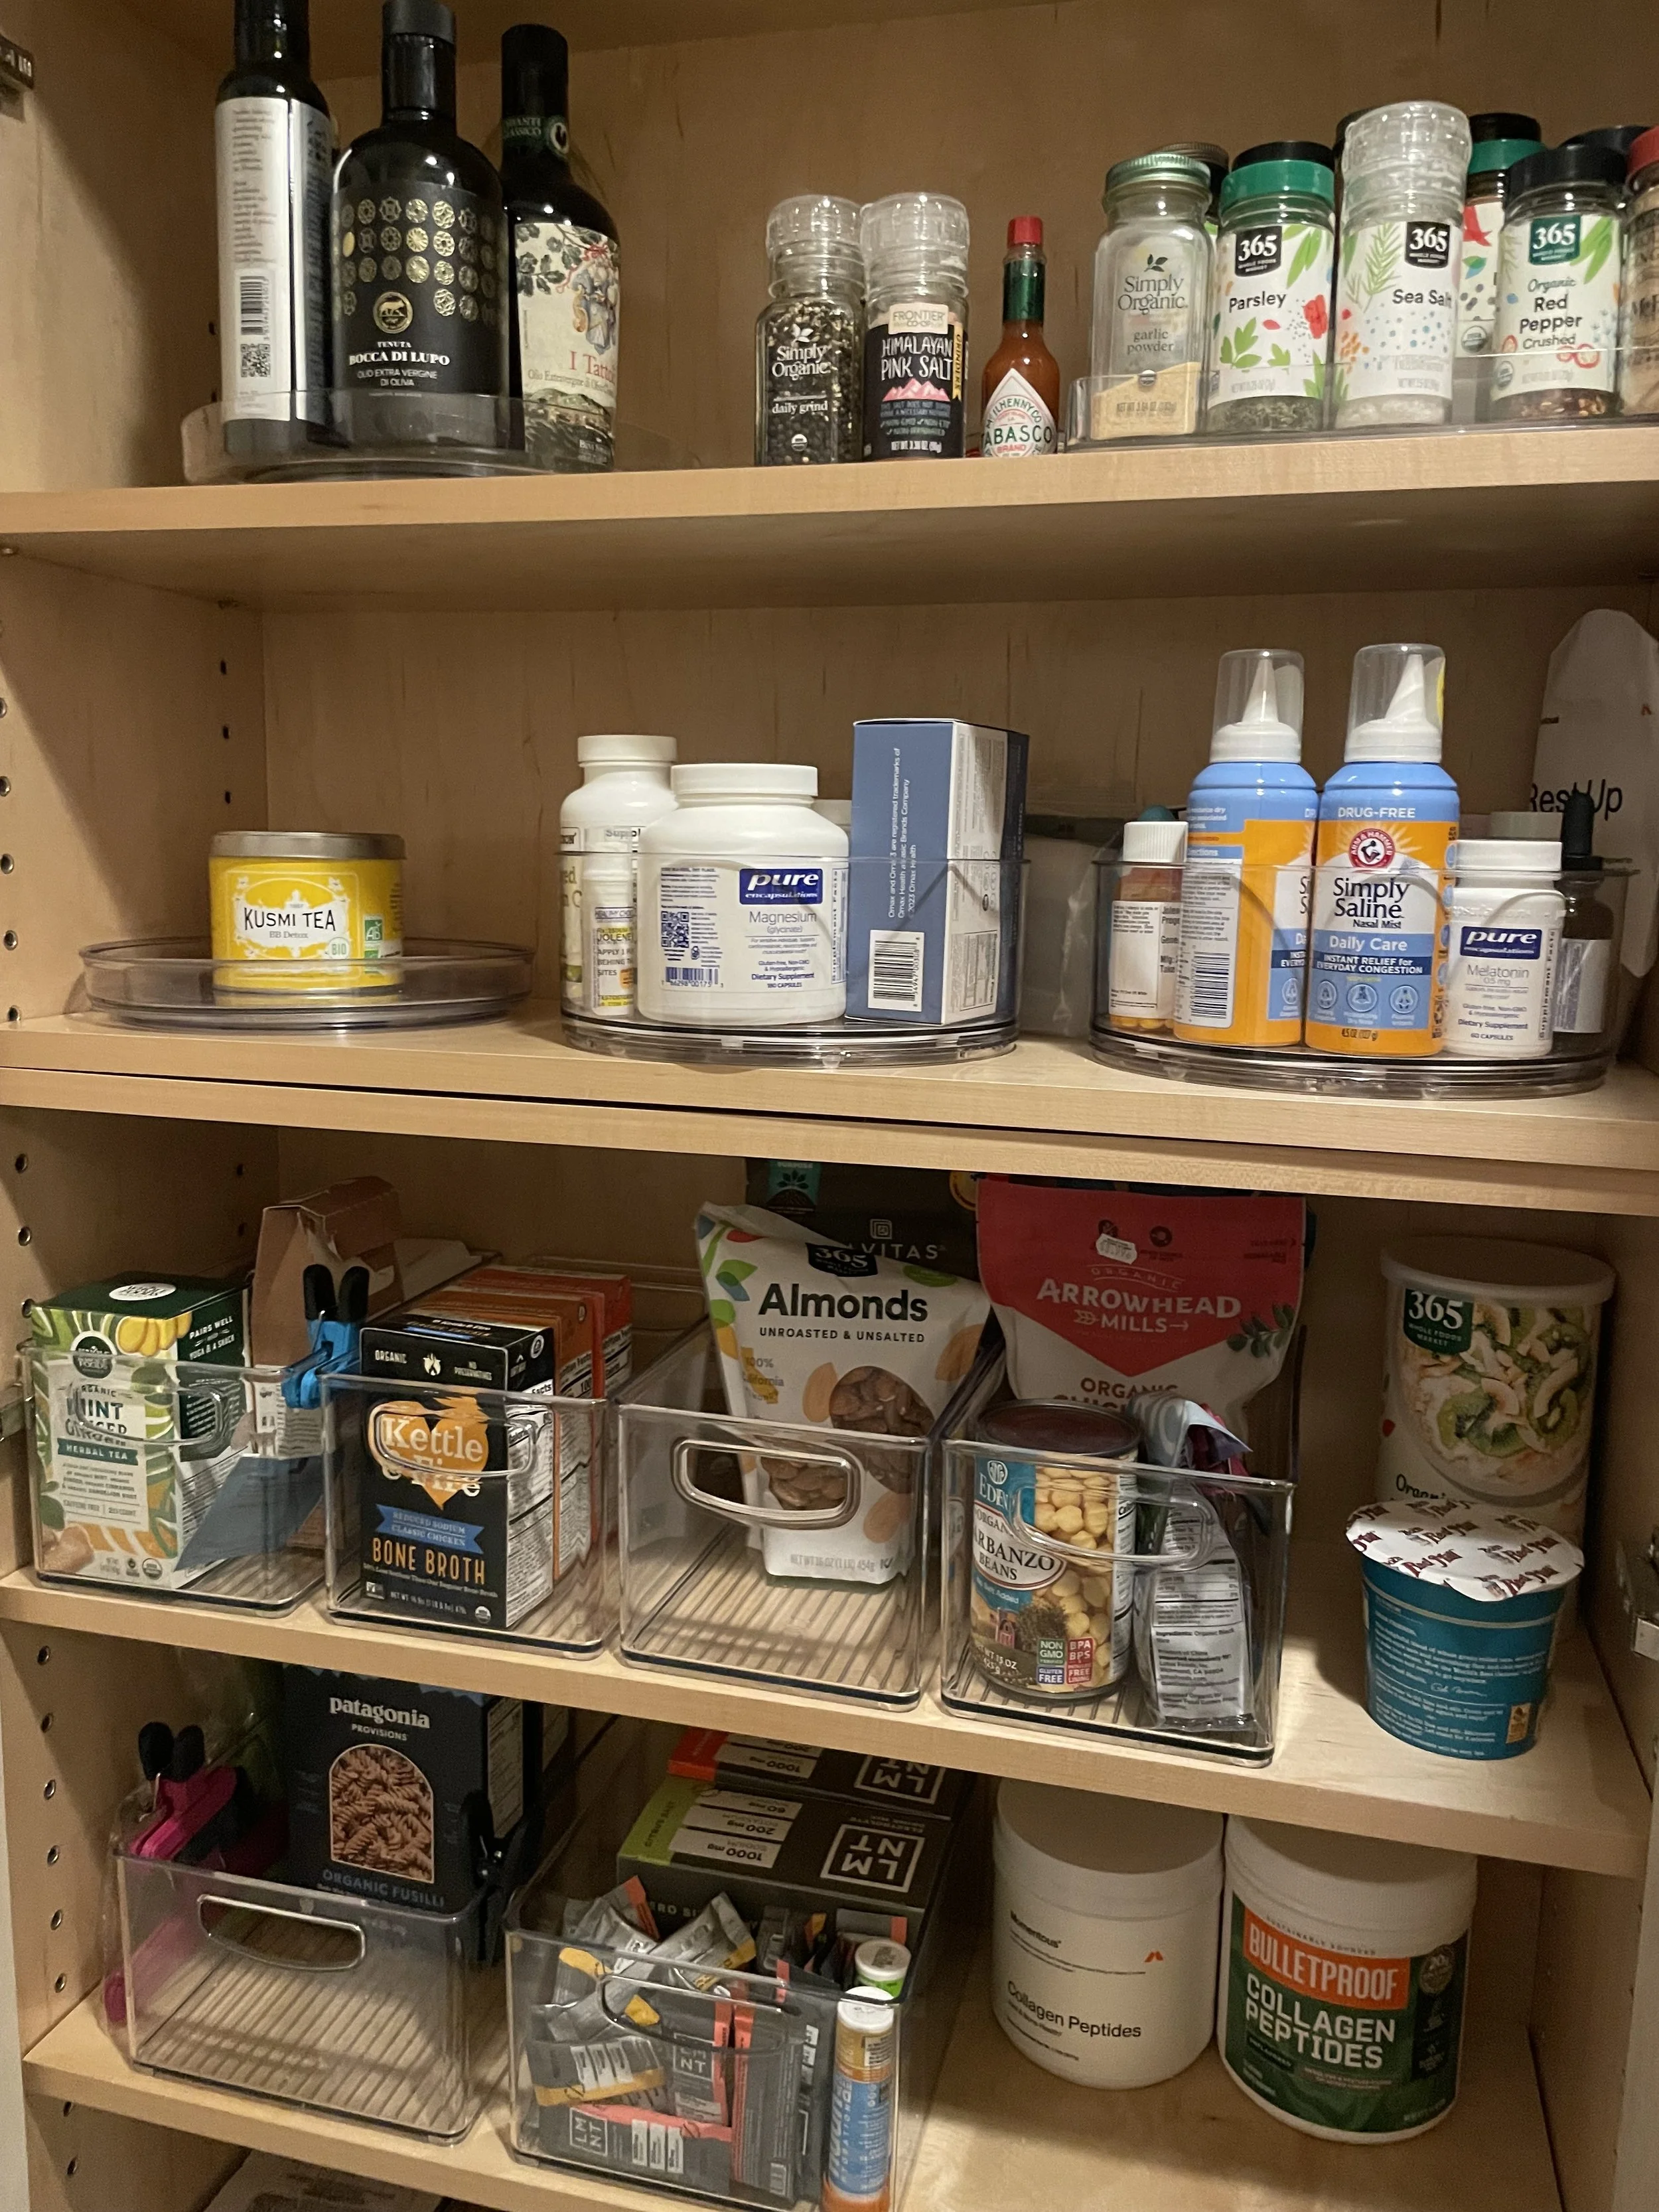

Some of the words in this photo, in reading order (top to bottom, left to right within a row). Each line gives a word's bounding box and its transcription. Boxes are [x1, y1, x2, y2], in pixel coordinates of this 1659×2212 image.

[1409, 227, 1448, 252] 365
[1532, 222, 1576, 250] 365
[1238, 234, 1277, 261] 365
[1124, 273, 1185, 297] Simply
[1527, 277, 1577, 293] Organic
[1228, 291, 1287, 313] Parsley
[1392, 289, 1424, 304] Sea
[1534, 293, 1569, 313] Red
[893, 311, 945, 322] FRONTIER
[1519, 315, 1583, 334] Pepper
[1133, 329, 1169, 343] garlic
[1522, 334, 1577, 350] Crushed
[776, 344, 825, 366] Simply
[881, 335, 953, 358] HIMALAYAN
[1127, 341, 1174, 356] powder
[349, 352, 388, 365] BOCCA
[392, 351, 407, 361] DI
[410, 352, 450, 366] LUPO
[772, 360, 830, 381] Organic
[881, 356, 913, 381] PINK
[918, 355, 953, 381] SALT
[772, 402, 798, 415] daily
[799, 401, 829, 415] grind
[901, 778, 910, 815] Company
[1585, 778, 1623, 822] Up
[1338, 807, 1416, 818] DRUG-FREE
[747, 873, 820, 891] pure
[1333, 876, 1411, 903] Simply
[745, 891, 818, 900] encapsulations
[1334, 897, 1404, 919] Saline
[244, 907, 297, 930] KUSMI
[302, 909, 336, 932] TEA
[749, 911, 817, 925] Magnesium
[1352, 919, 1378, 929] Nasal
[1381, 919, 1402, 929] Mist
[1329, 935, 1366, 952] Daily
[1369, 938, 1408, 952] Care
[1465, 931, 1537, 945] pure
[331, 943, 347, 956] BIO
[1317, 960, 1357, 973] EVERYDAY
[1358, 965, 1423, 974] CONGESTION
[1324, 954, 1359, 964] INSTANT
[1360, 956, 1397, 966] RELIEF
[1398, 958, 1413, 966] for
[751, 973, 777, 982] Dietary
[1467, 964, 1530, 979] Melatonin
[1458, 1019, 1482, 1028] Dietary
[1484, 1021, 1528, 1029] Supplement
[814, 1246, 869, 1270] 365
[849, 1243, 938, 1260] VITAS
[1090, 1267, 1183, 1290] ORGANIC
[758, 1283, 928, 1322] Almonds
[1036, 1278, 1242, 1319] ARROWHEAD
[1408, 1290, 1463, 1329] 365
[189, 1324, 213, 1340] PAIRS
[214, 1315, 234, 1329] WELL
[1100, 1314, 1168, 1333] MILLS
[759, 1327, 838, 1339] UNROASTED
[843, 1331, 851, 1340] &
[856, 1331, 925, 1343] UNSALTED
[374, 1349, 407, 1364] ORGANIC
[81, 1384, 116, 1398] RGANIC
[382, 1416, 484, 1462] Kettle
[66, 1443, 104, 1457] HERBAL
[109, 1450, 128, 1460] TEA
[433, 1520, 465, 1534] SODIUM
[372, 1537, 417, 1572] BONE
[425, 1549, 485, 1585] BROTH
[979, 1550, 1017, 1581] BEANS
[1040, 1640, 1063, 1649] NON
[1070, 1640, 1091, 1651] BPA
[1039, 1650, 1063, 1659] GMO
[1069, 1650, 1091, 1660] BPS
[1005, 1659, 1017, 1670] OZ
[1068, 1668, 1090, 1676] FREE
[1039, 1674, 1063, 1684] FREE
[329, 1696, 431, 1730] patagonia
[351, 1723, 407, 1741] PROVISIONS
[766, 1761, 801, 1773] 1000
[872, 1769, 925, 1793] LM
[726, 1820, 745, 1829] mg
[745, 1824, 776, 1836] 200
[707, 1843, 725, 1852] mg
[849, 1834, 906, 1856] NT
[729, 1847, 763, 1862] 1000
[840, 1852, 899, 1881] LM
[322, 1868, 389, 1896] ORGANIC
[391, 1885, 445, 1907] FUSILLI
[1250, 1922, 1399, 2002] BULLETPROOF
[1007, 1980, 1064, 2026] Collagen
[1068, 2016, 1141, 2037] Peptides
[1247, 1972, 1395, 2043] COLLAGEN
[1245, 1996, 1384, 2069] PEPTIDES
[680, 2060, 707, 2073] NT
[575, 2116, 587, 2144] LM
[589, 2121, 603, 2148] NT
